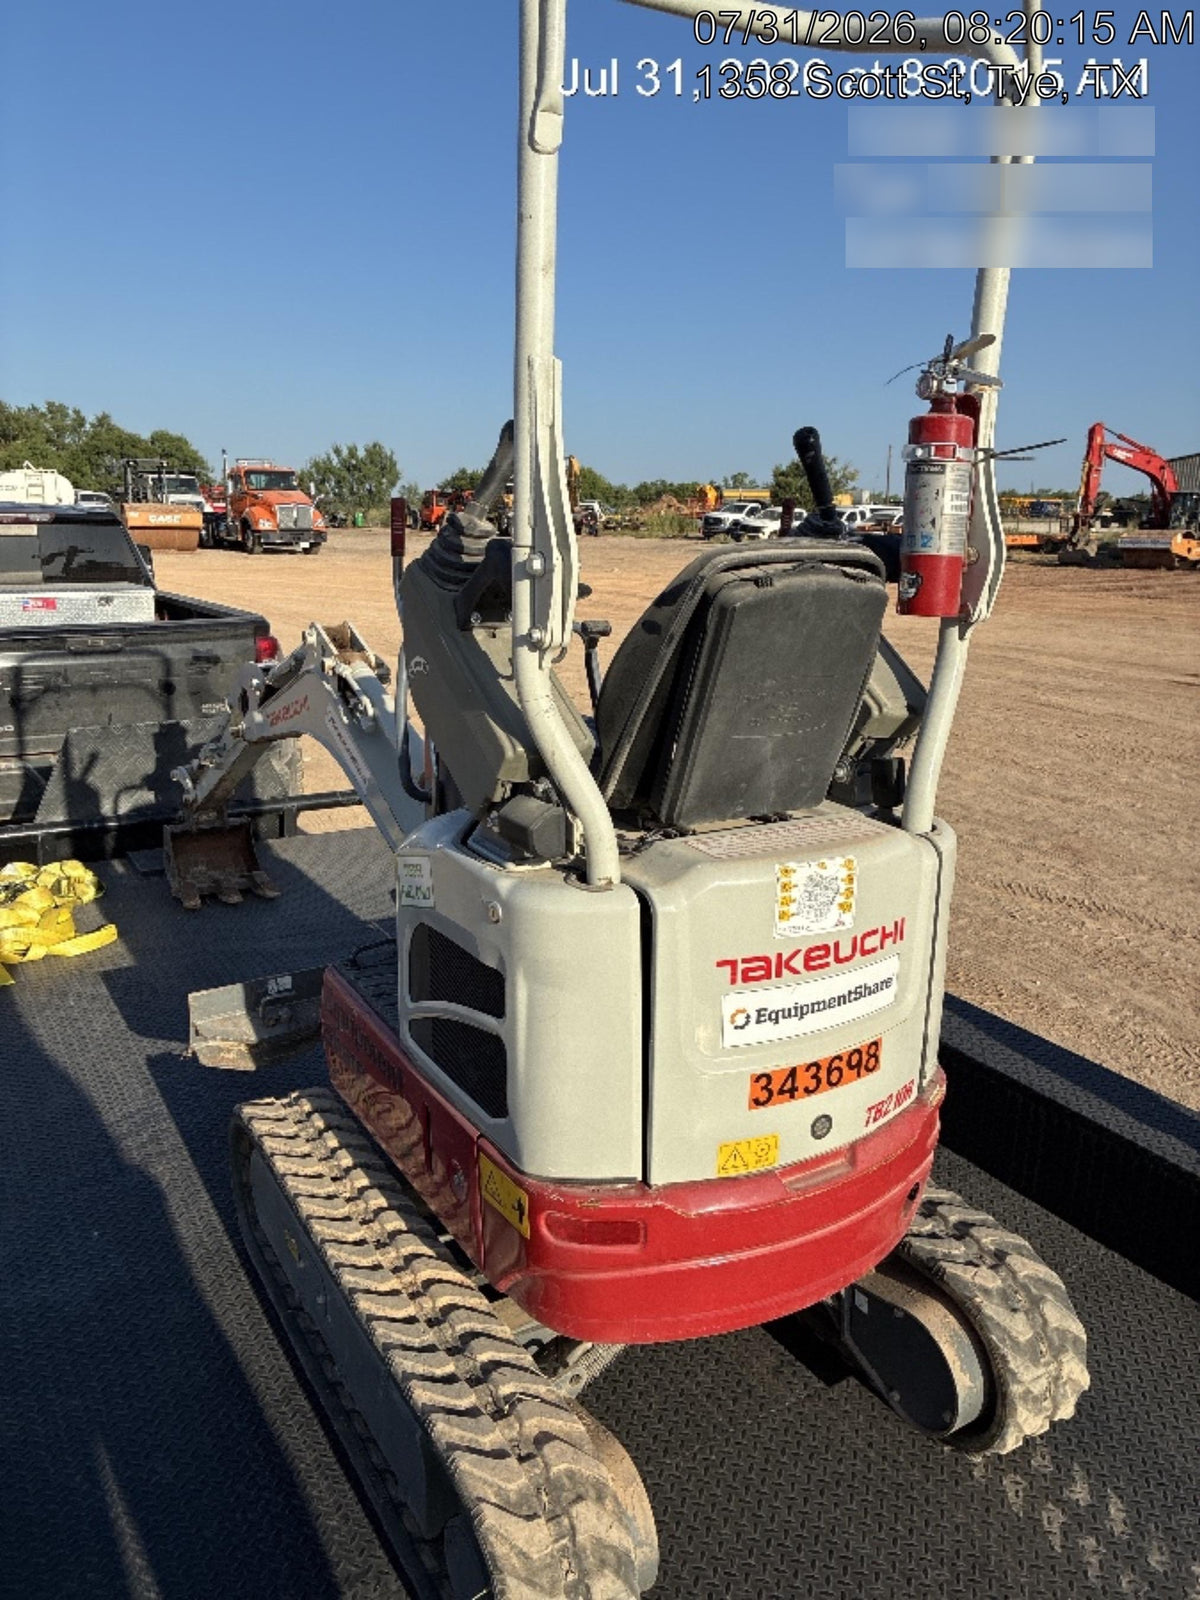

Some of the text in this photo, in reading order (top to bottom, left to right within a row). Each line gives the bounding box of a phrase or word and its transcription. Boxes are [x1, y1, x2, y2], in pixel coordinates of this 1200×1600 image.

[715, 917, 906, 985] TAKEUCHI
[755, 977, 893, 1026] EquipmentShare
[752, 1040, 880, 1107] 343698
